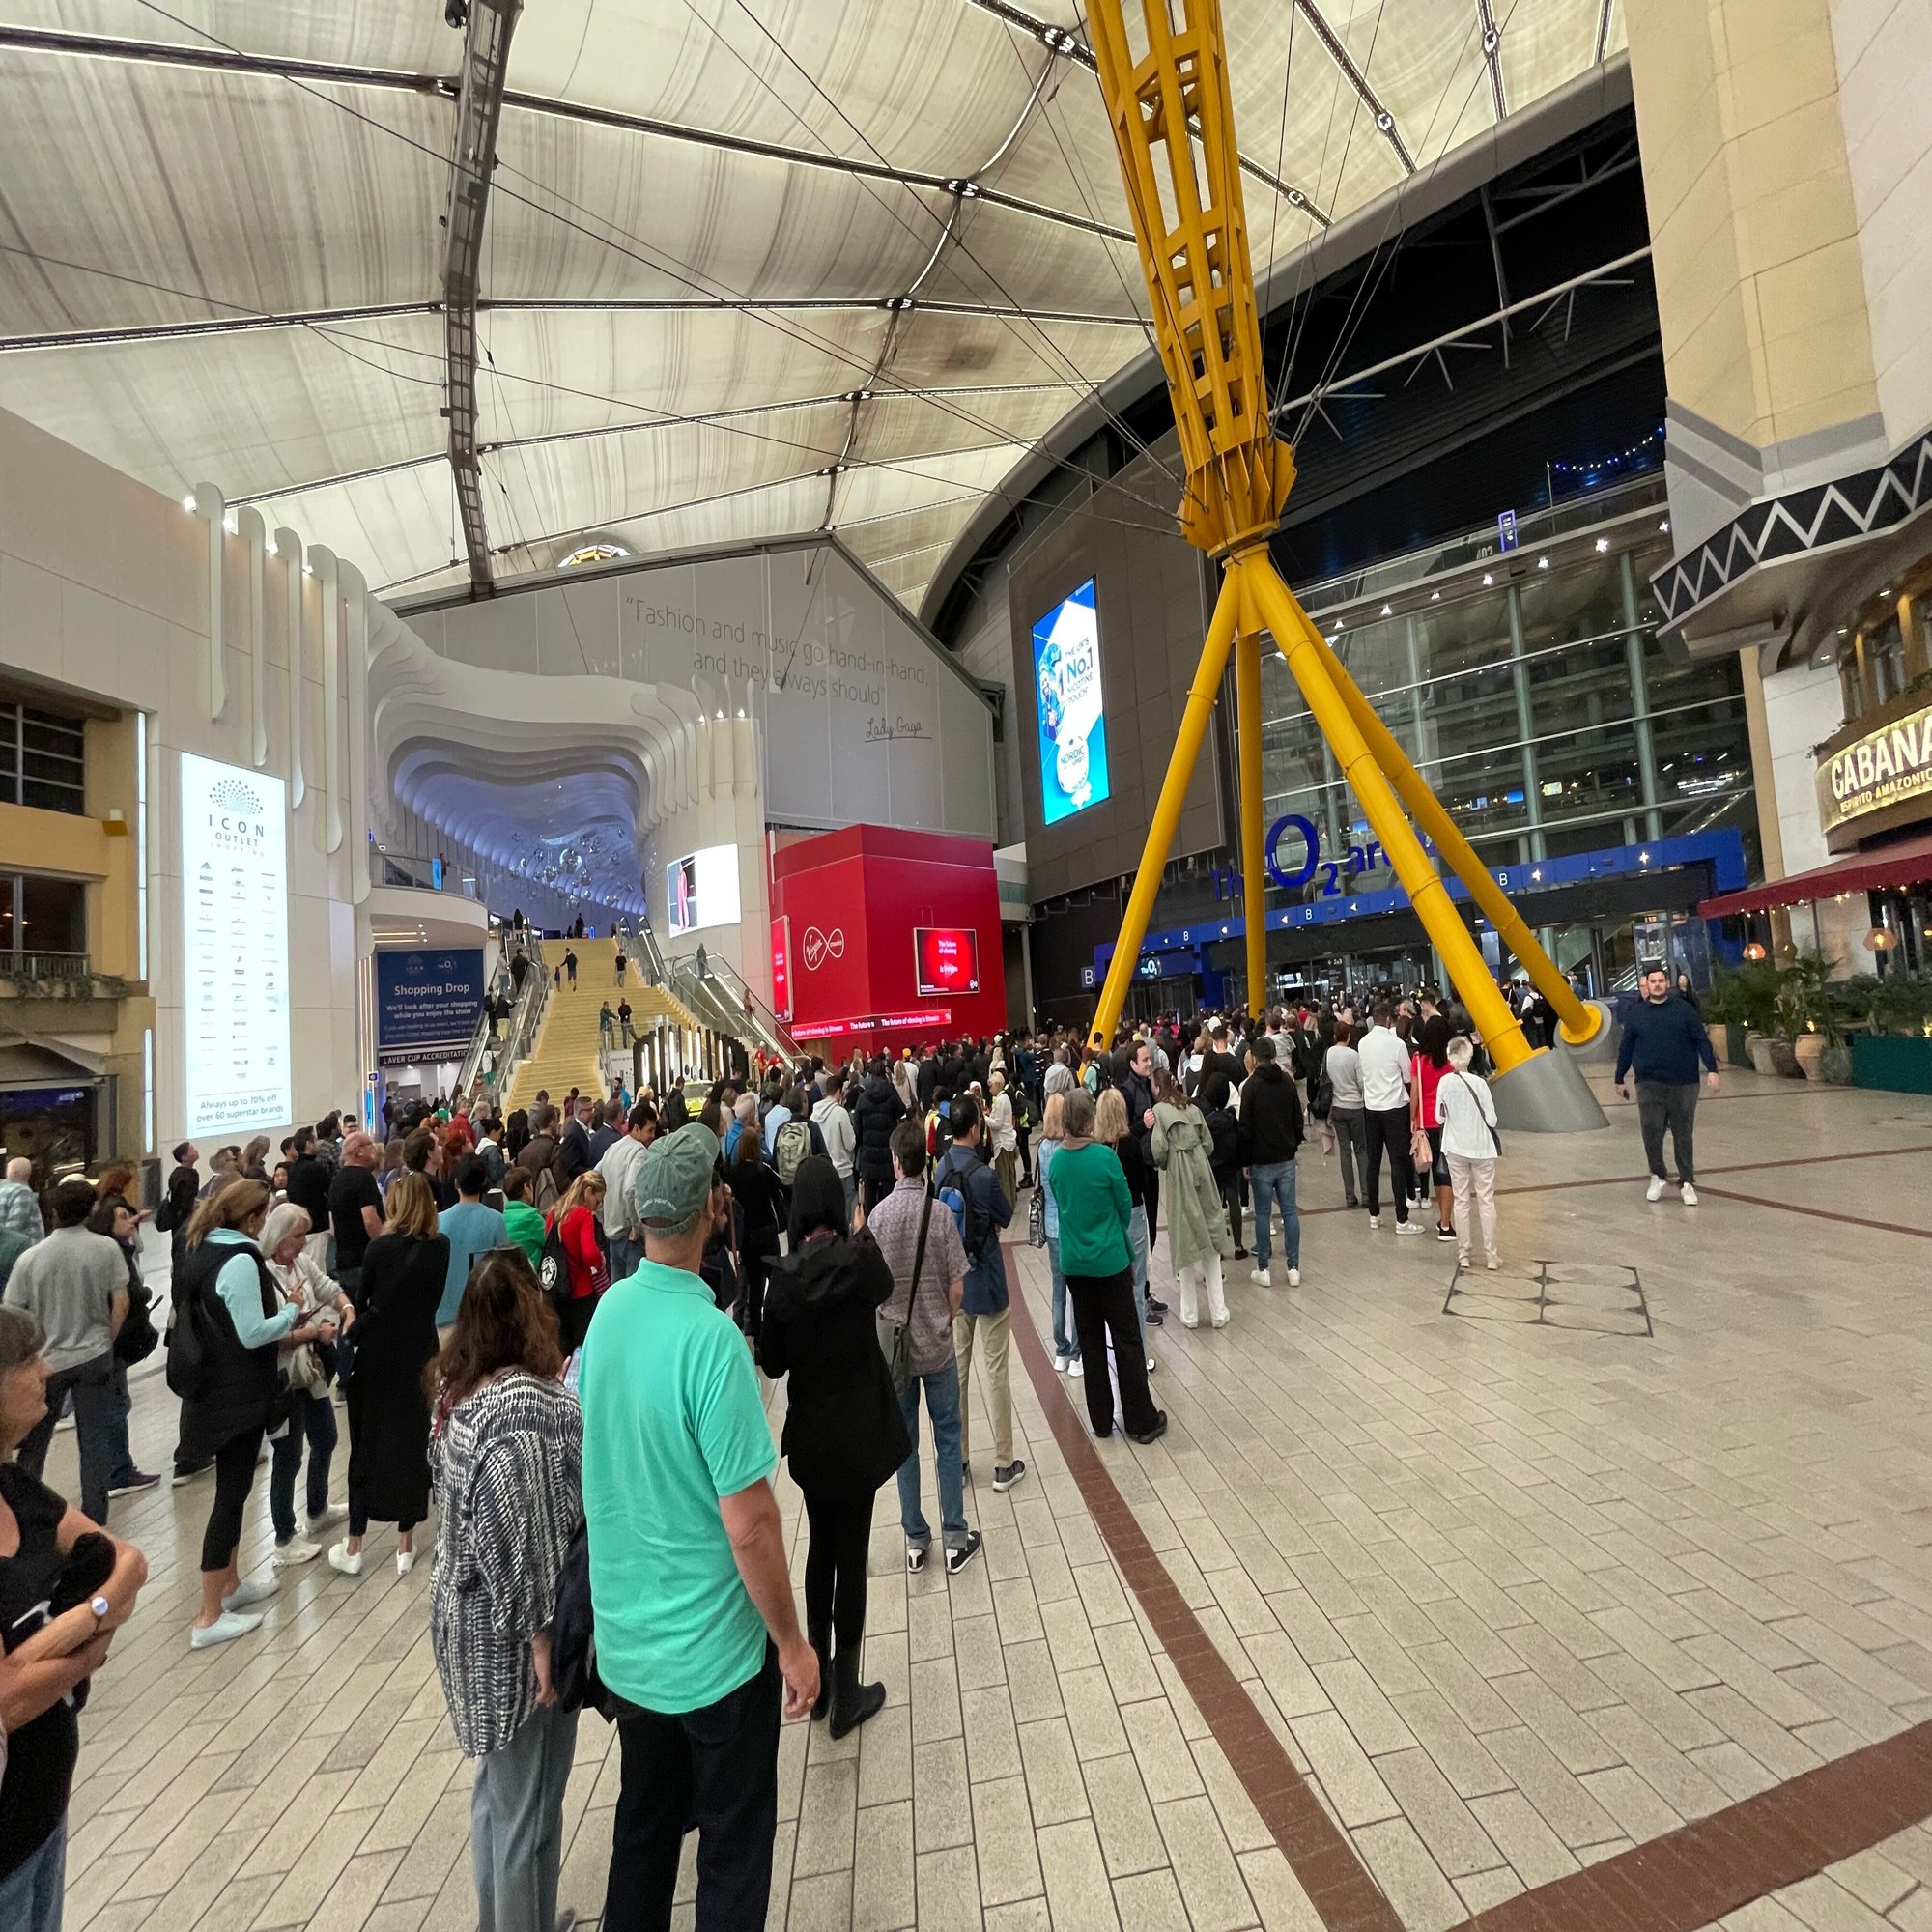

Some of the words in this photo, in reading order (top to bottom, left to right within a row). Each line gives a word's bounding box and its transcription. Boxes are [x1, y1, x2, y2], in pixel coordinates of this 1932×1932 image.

[712, 621, 745, 643] and
[752, 631, 797, 657] music
[803, 643, 824, 666] go
[829, 643, 928, 686] hand-in-hand,
[693, 652, 726, 674] and
[732, 656, 769, 690] they
[775, 666, 827, 699] always
[866, 717, 894, 741] Lady
[896, 716, 923, 737] Gaga
[1061, 746, 1085, 765] NORDIC
[1832, 714, 1932, 800] CABANA
[209, 814, 265, 838] ICON
[215, 832, 259, 847] OUTLET
[1499, 872, 1508, 886] B
[1306, 908, 1313, 920] B
[1183, 930, 1189, 941] B
[1085, 969, 1094, 984] B
[394, 984, 442, 997] Shopping
[445, 983, 470, 995] Drop
[383, 1055, 406, 1065] LAVER
[407, 1053, 420, 1062] CUP
[200, 1100, 227, 1110] Always
[250, 1095, 265, 1104] 70%
[267, 1094, 277, 1102] off
[196, 1113, 213, 1122] over
[215, 1111, 224, 1120] 60
[226, 1108, 259, 1119] superstar
[261, 1105, 284, 1114] brands
